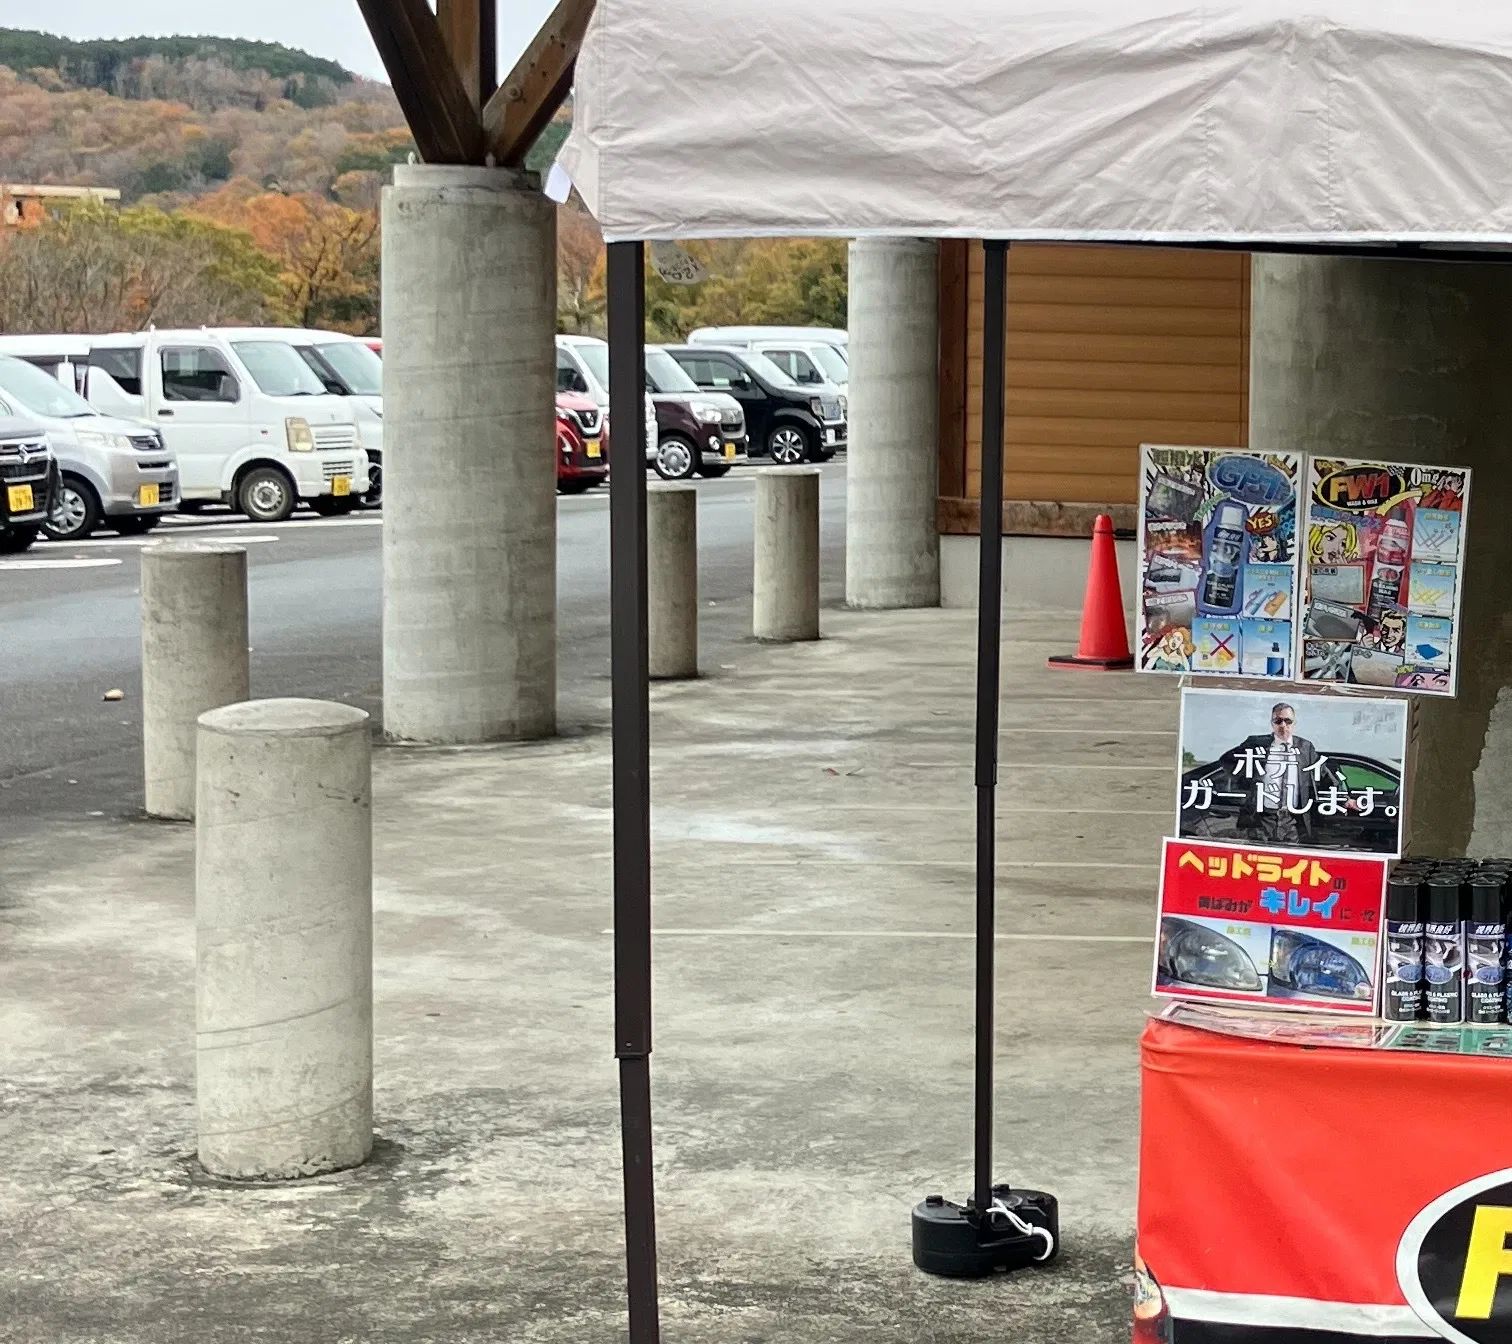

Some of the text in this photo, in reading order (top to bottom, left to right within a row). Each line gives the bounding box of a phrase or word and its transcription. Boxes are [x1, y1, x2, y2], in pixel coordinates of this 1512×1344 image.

[1330, 472, 1390, 502] FW1
[1232, 747, 1347, 782] ボディ、
[1182, 779, 1399, 817] ガードします。
